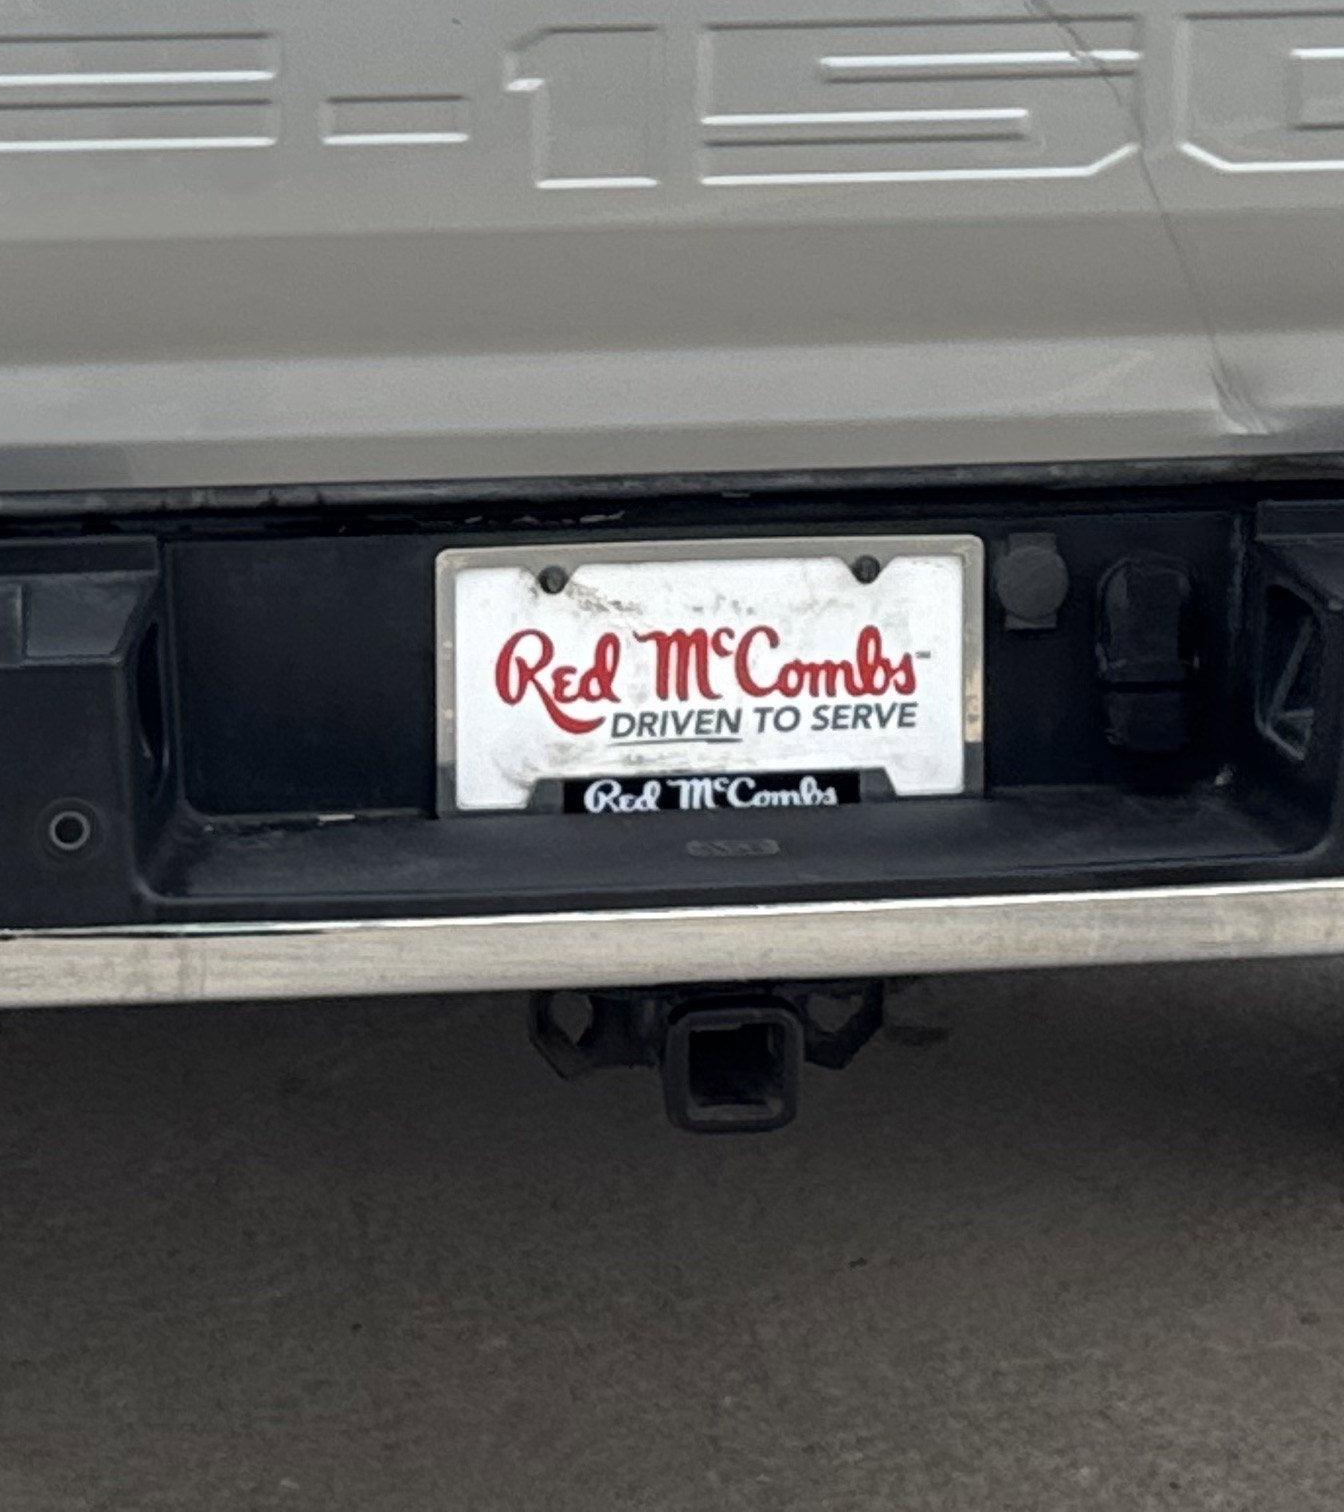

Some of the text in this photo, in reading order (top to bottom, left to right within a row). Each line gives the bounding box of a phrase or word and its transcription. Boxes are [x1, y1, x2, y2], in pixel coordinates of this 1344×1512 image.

[494, 627, 622, 735] Red
[609, 700, 919, 739] DRIVEN TO SERVE
[582, 778, 662, 814] Red
